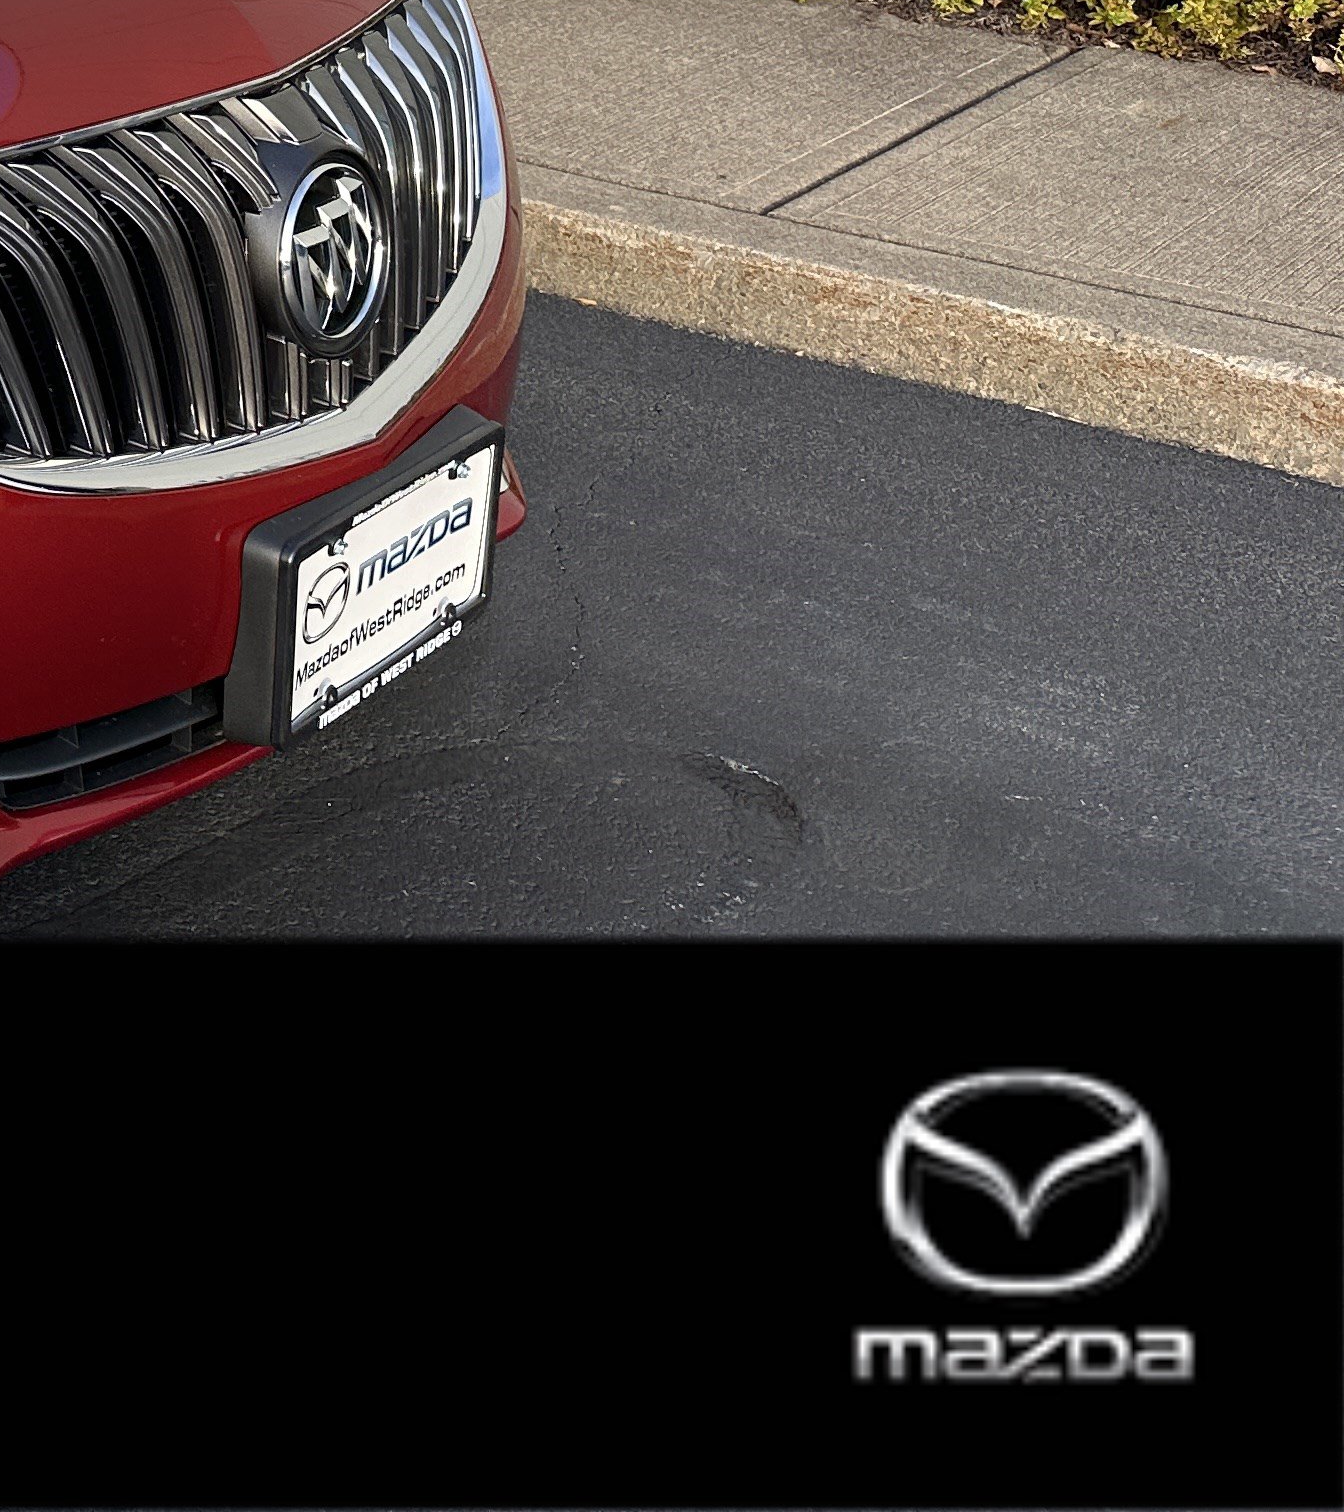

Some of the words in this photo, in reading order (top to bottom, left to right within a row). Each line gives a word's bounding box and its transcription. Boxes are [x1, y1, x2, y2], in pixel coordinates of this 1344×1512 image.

[356, 497, 472, 596] mazda
[295, 563, 466, 691] MazdaofWestRidge.com
[362, 677, 379, 699] OF
[381, 652, 415, 686] WEST
[416, 627, 452, 662] RIDGE
